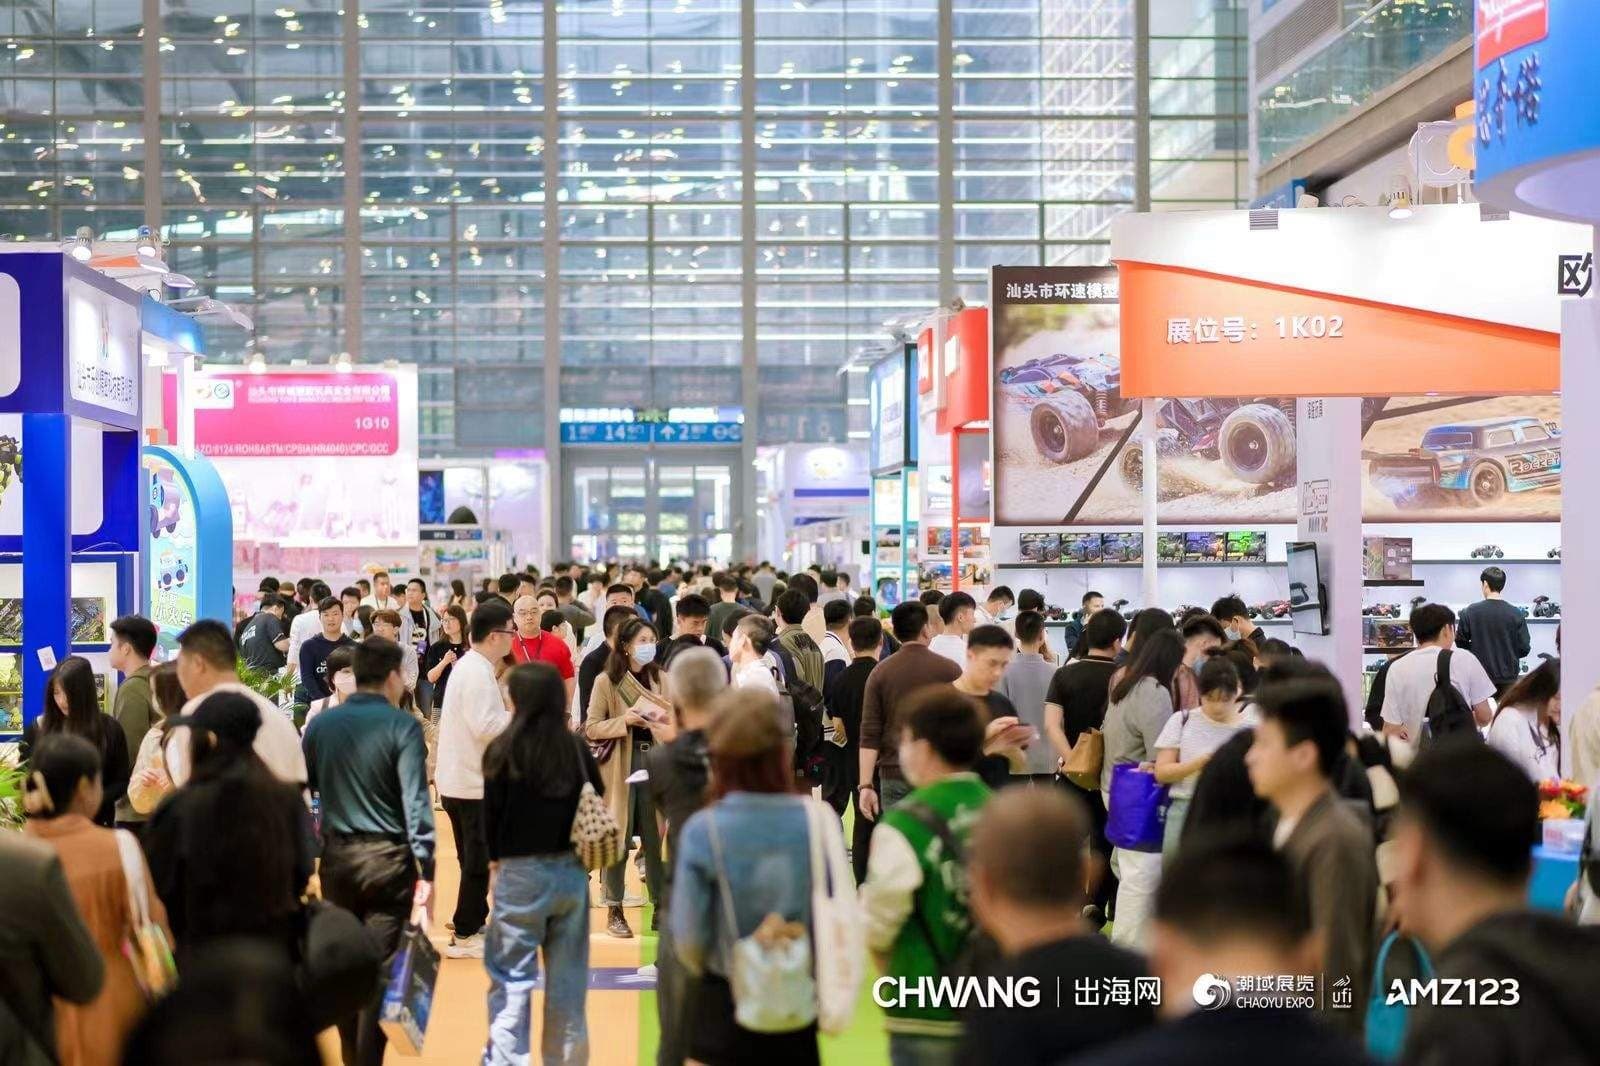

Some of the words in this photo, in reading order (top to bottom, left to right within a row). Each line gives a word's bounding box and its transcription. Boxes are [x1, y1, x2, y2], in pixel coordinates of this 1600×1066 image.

[1006, 283, 1120, 300] 汕头市环速模型
[1275, 315, 1344, 339] 1K02
[355, 417, 389, 430] 1G10
[569, 424, 576, 441] 1
[605, 425, 625, 441] 14
